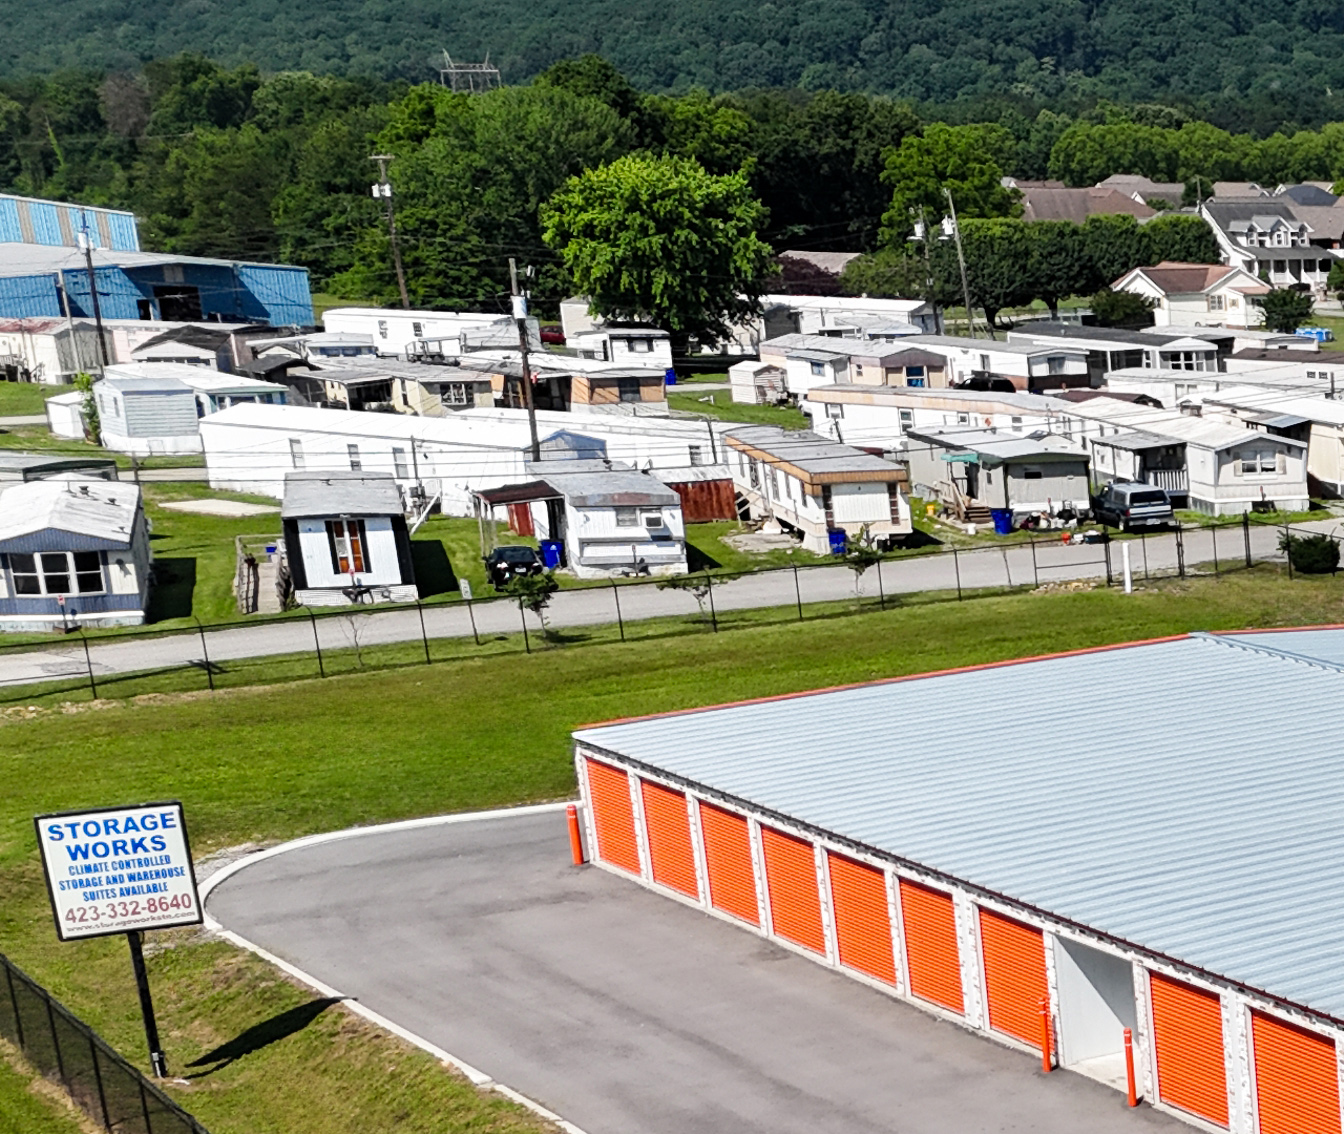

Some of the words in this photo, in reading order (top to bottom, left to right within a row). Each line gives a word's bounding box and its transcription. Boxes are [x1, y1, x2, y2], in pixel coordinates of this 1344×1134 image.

[48, 812, 177, 841] STORAGE
[65, 835, 167, 861] WORKS
[68, 862, 109, 876] CLIMATE
[111, 854, 171, 871] CONTROLLED
[59, 877, 104, 891] STORAGE
[106, 873, 125, 886] AND
[126, 866, 186, 883] WAREHOUSE
[83, 887, 117, 902] SUITES
[119, 882, 168, 898] AVAILABLE
[65, 893, 192, 923] 423-332-8640
